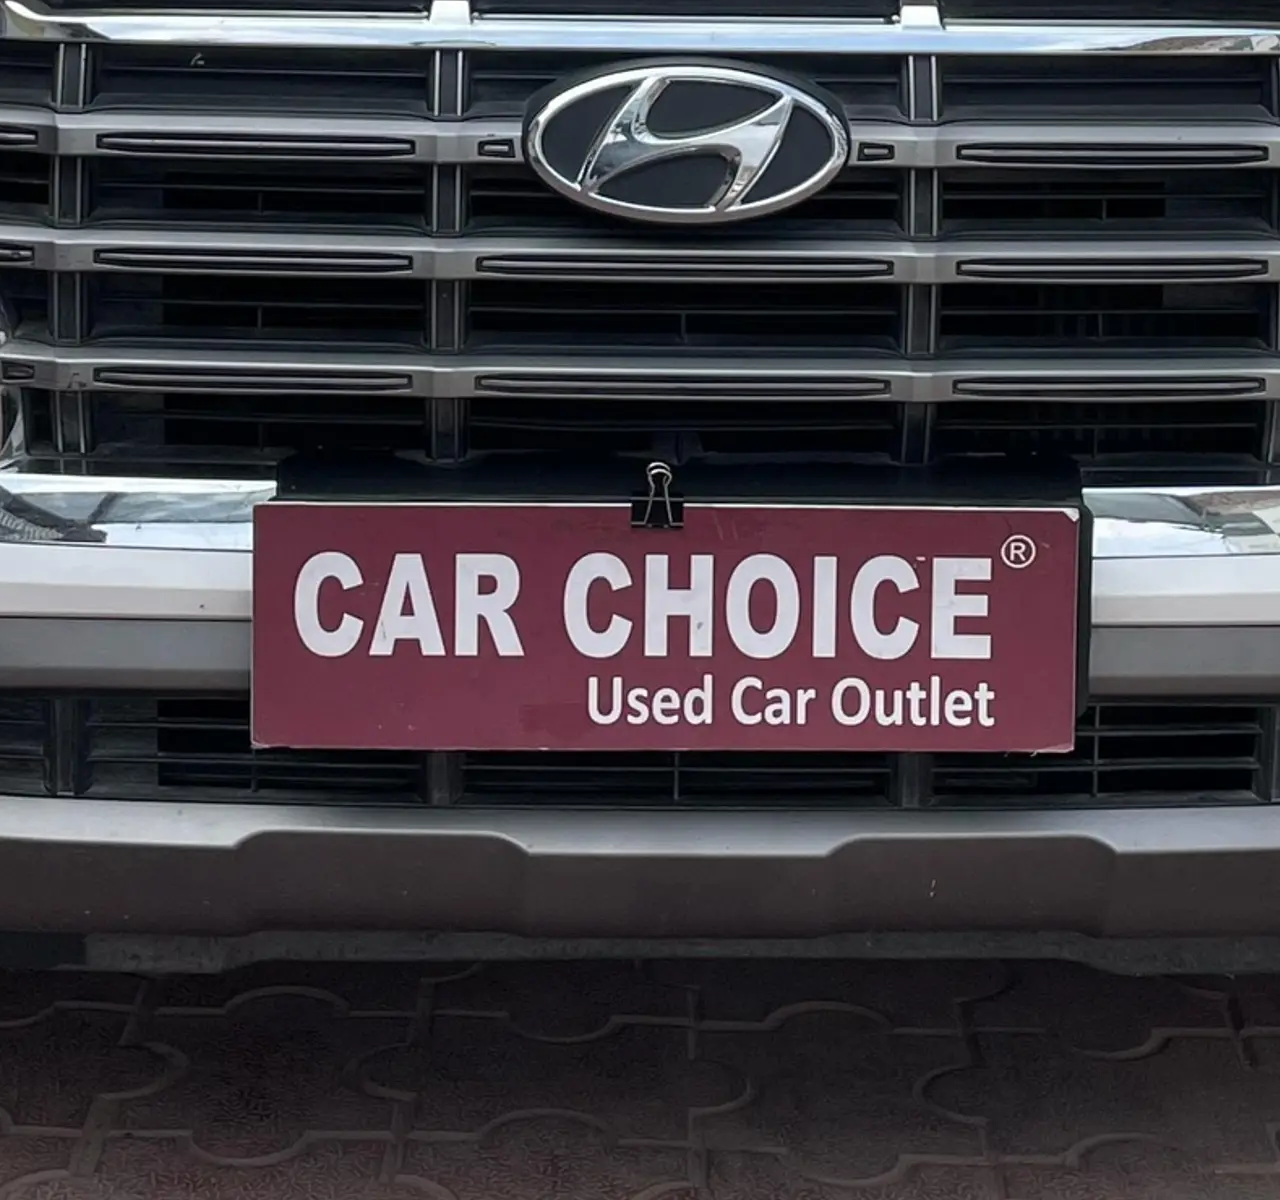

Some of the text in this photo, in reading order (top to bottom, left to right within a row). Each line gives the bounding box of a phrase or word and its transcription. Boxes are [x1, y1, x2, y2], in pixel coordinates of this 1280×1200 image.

[292, 550, 524, 657] CAR
[588, 674, 996, 728] Used Car Outlet
